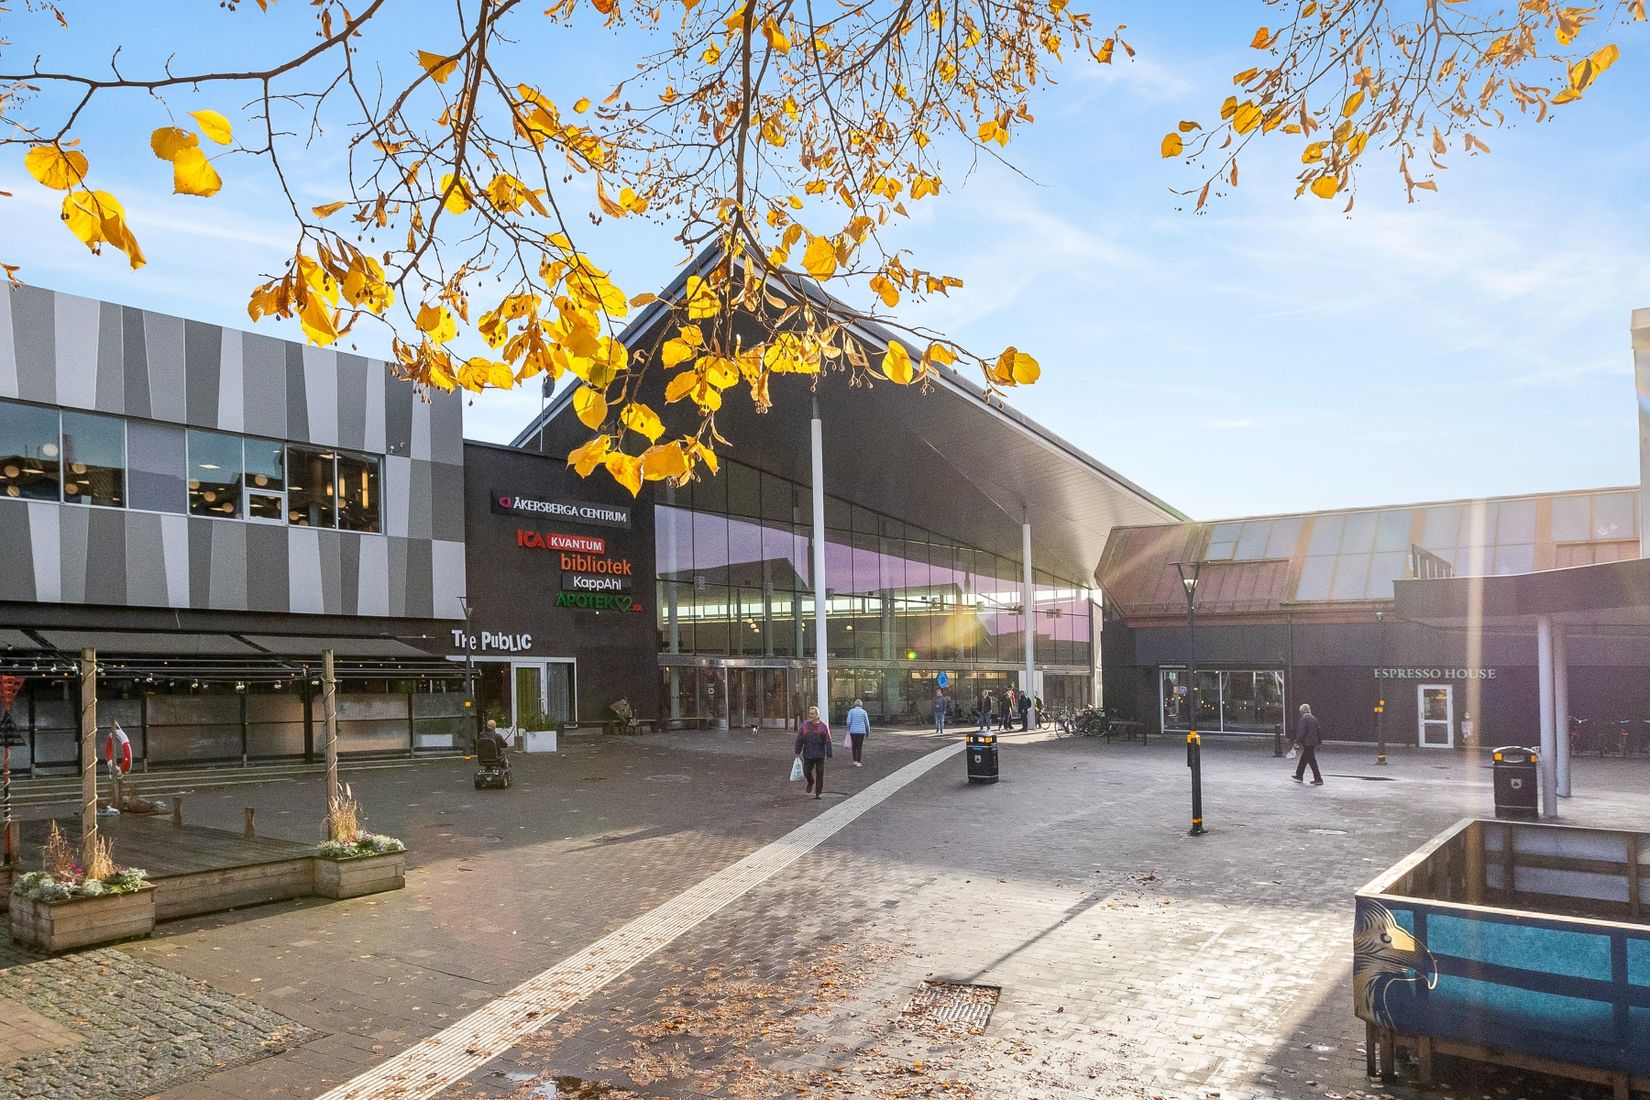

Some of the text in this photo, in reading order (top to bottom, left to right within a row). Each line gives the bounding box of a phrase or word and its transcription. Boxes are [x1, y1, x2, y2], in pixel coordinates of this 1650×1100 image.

[513, 497, 627, 523] ÅKERSBERGA CENTRUM
[516, 530, 602, 551] ICA KVANTUM
[561, 554, 631, 575] bibliotek
[573, 576, 622, 590] KappAhl
[556, 592, 613, 608] APOTEK
[1374, 668, 1497, 679] ESPRESSO HOUSE
